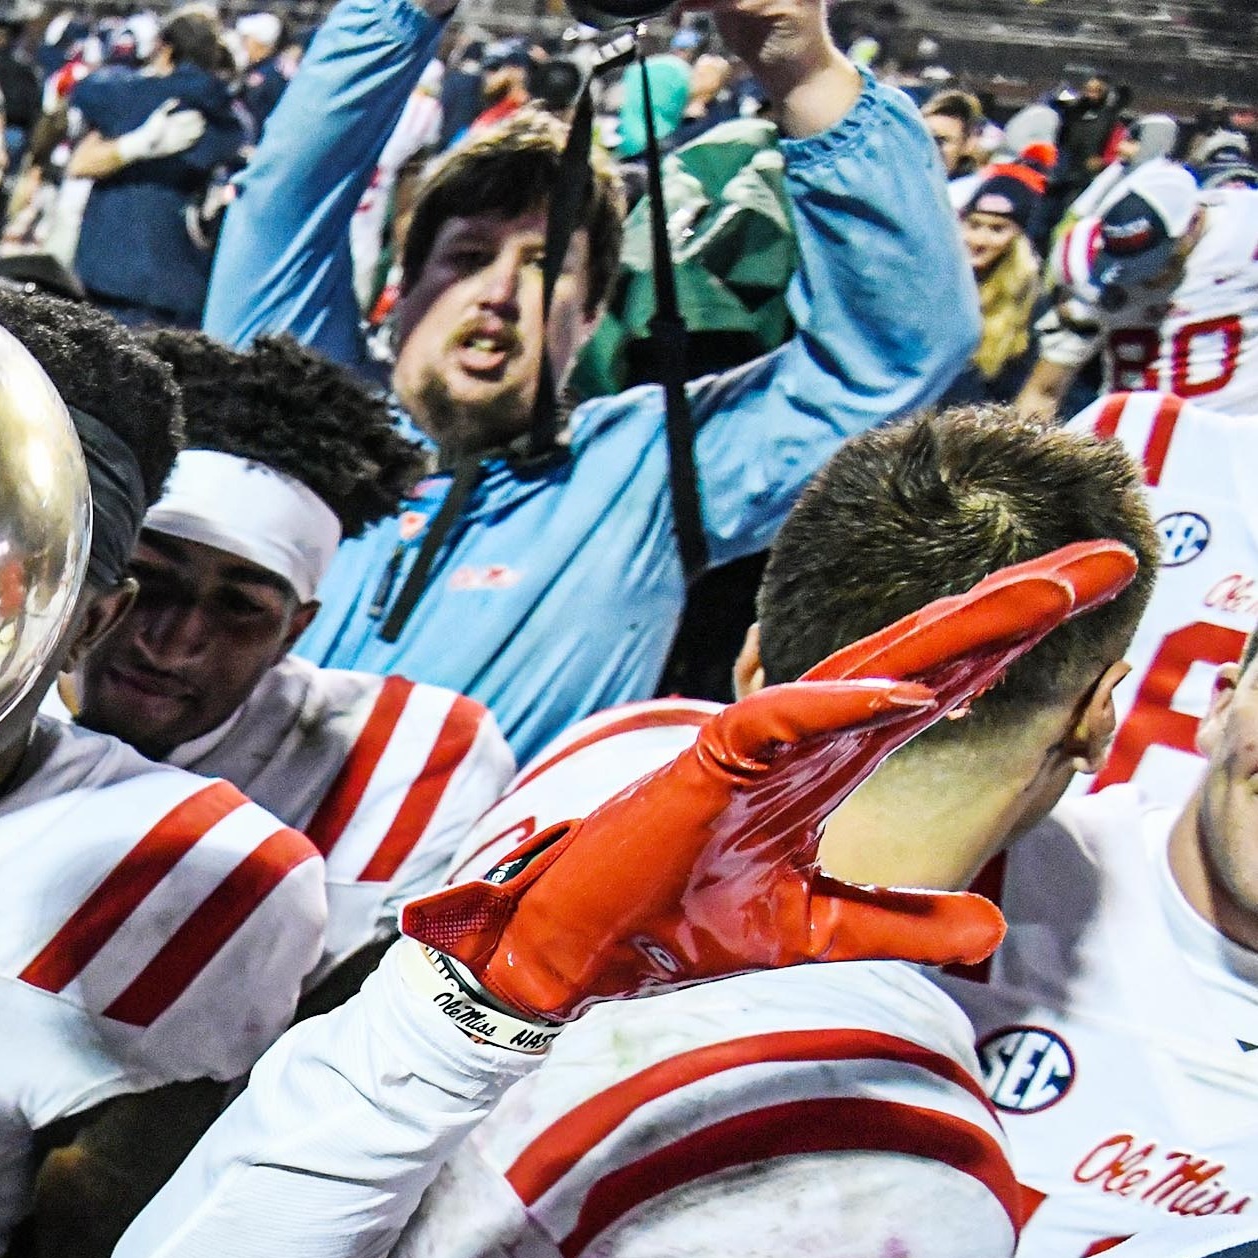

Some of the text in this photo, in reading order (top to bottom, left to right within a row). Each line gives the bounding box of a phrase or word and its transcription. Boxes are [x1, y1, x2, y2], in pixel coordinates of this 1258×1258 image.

[433, 992, 463, 1018] Ole
[456, 1005, 498, 1037] Miss
[978, 1029, 1073, 1110] SEC
[1074, 1134, 1252, 1217] Ole Miss
